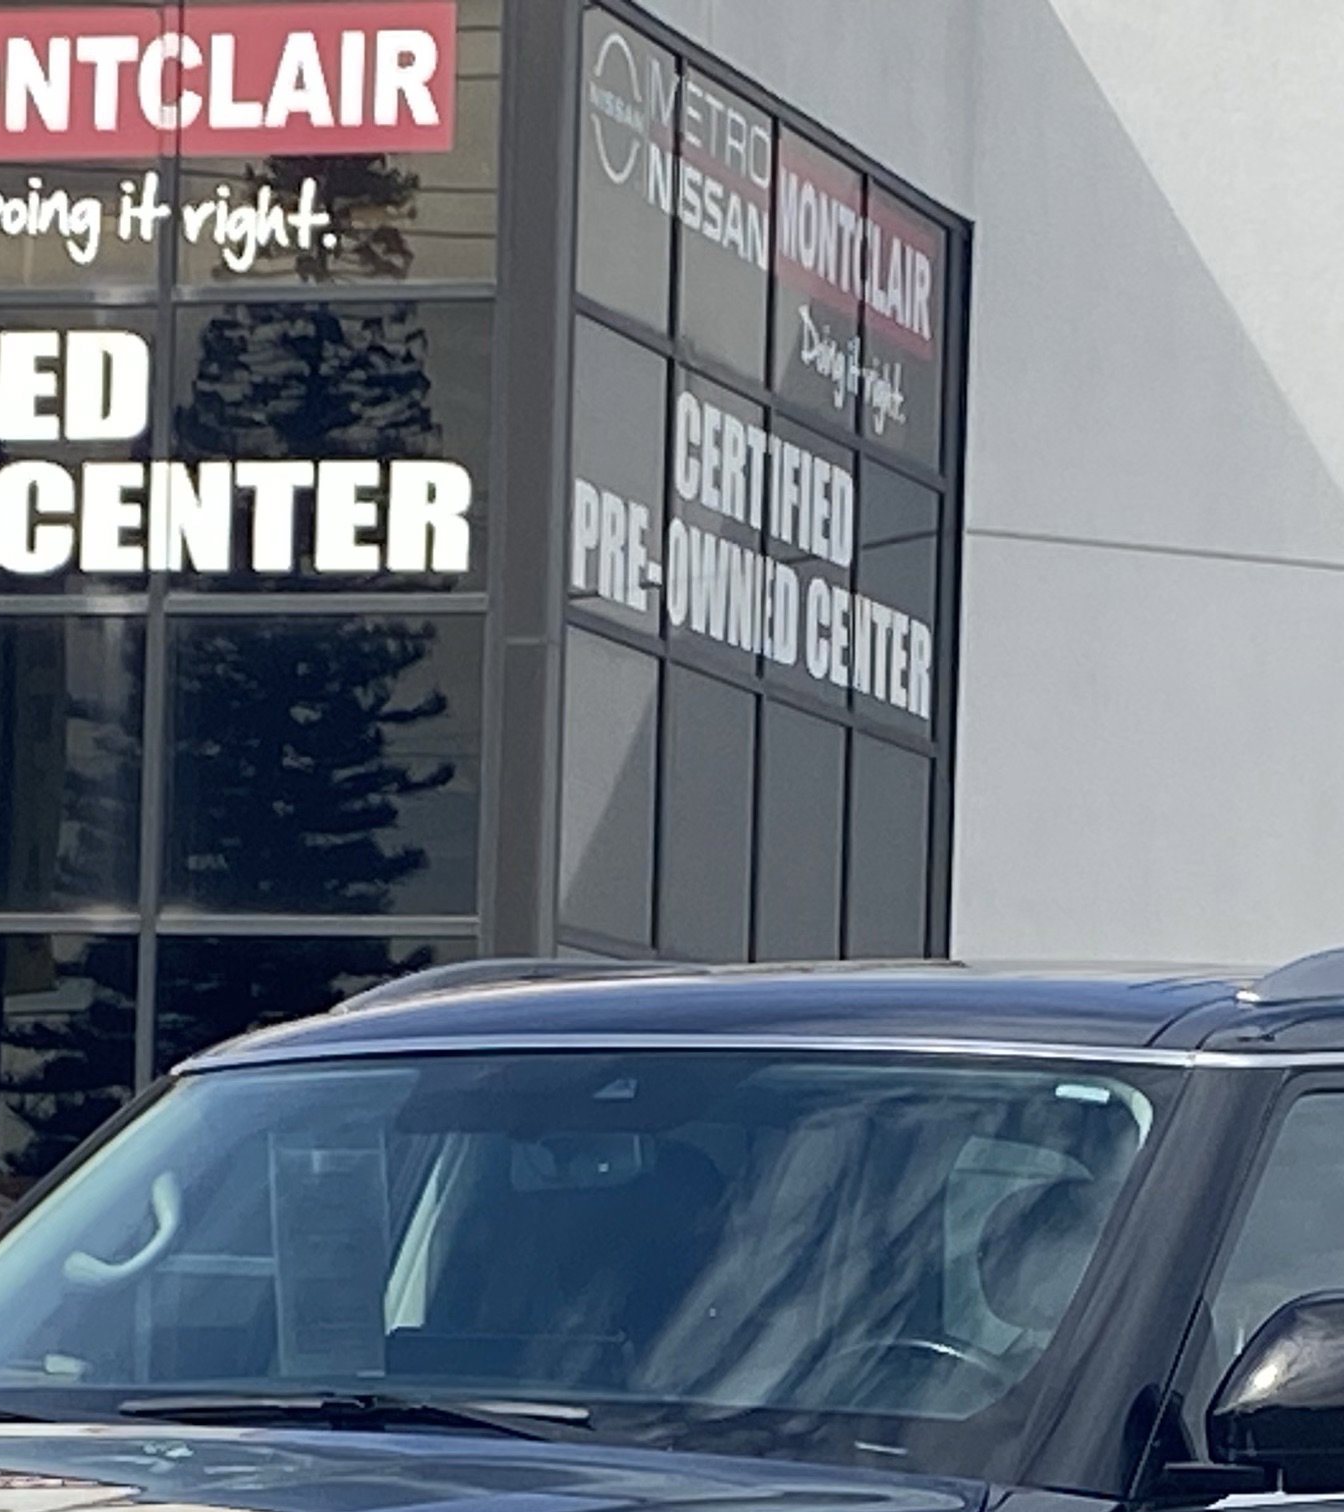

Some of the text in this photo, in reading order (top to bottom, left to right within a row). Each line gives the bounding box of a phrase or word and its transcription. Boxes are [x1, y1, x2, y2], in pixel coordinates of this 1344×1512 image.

[650, 58, 771, 190] METRO
[118, 171, 171, 243] it
[182, 177, 339, 273] right.
[647, 141, 769, 271] NISSAN
[780, 166, 931, 341] MONTCLAIR
[674, 391, 854, 568] CERTIFIED
[571, 477, 932, 721] PRE-OWNED CENTER
